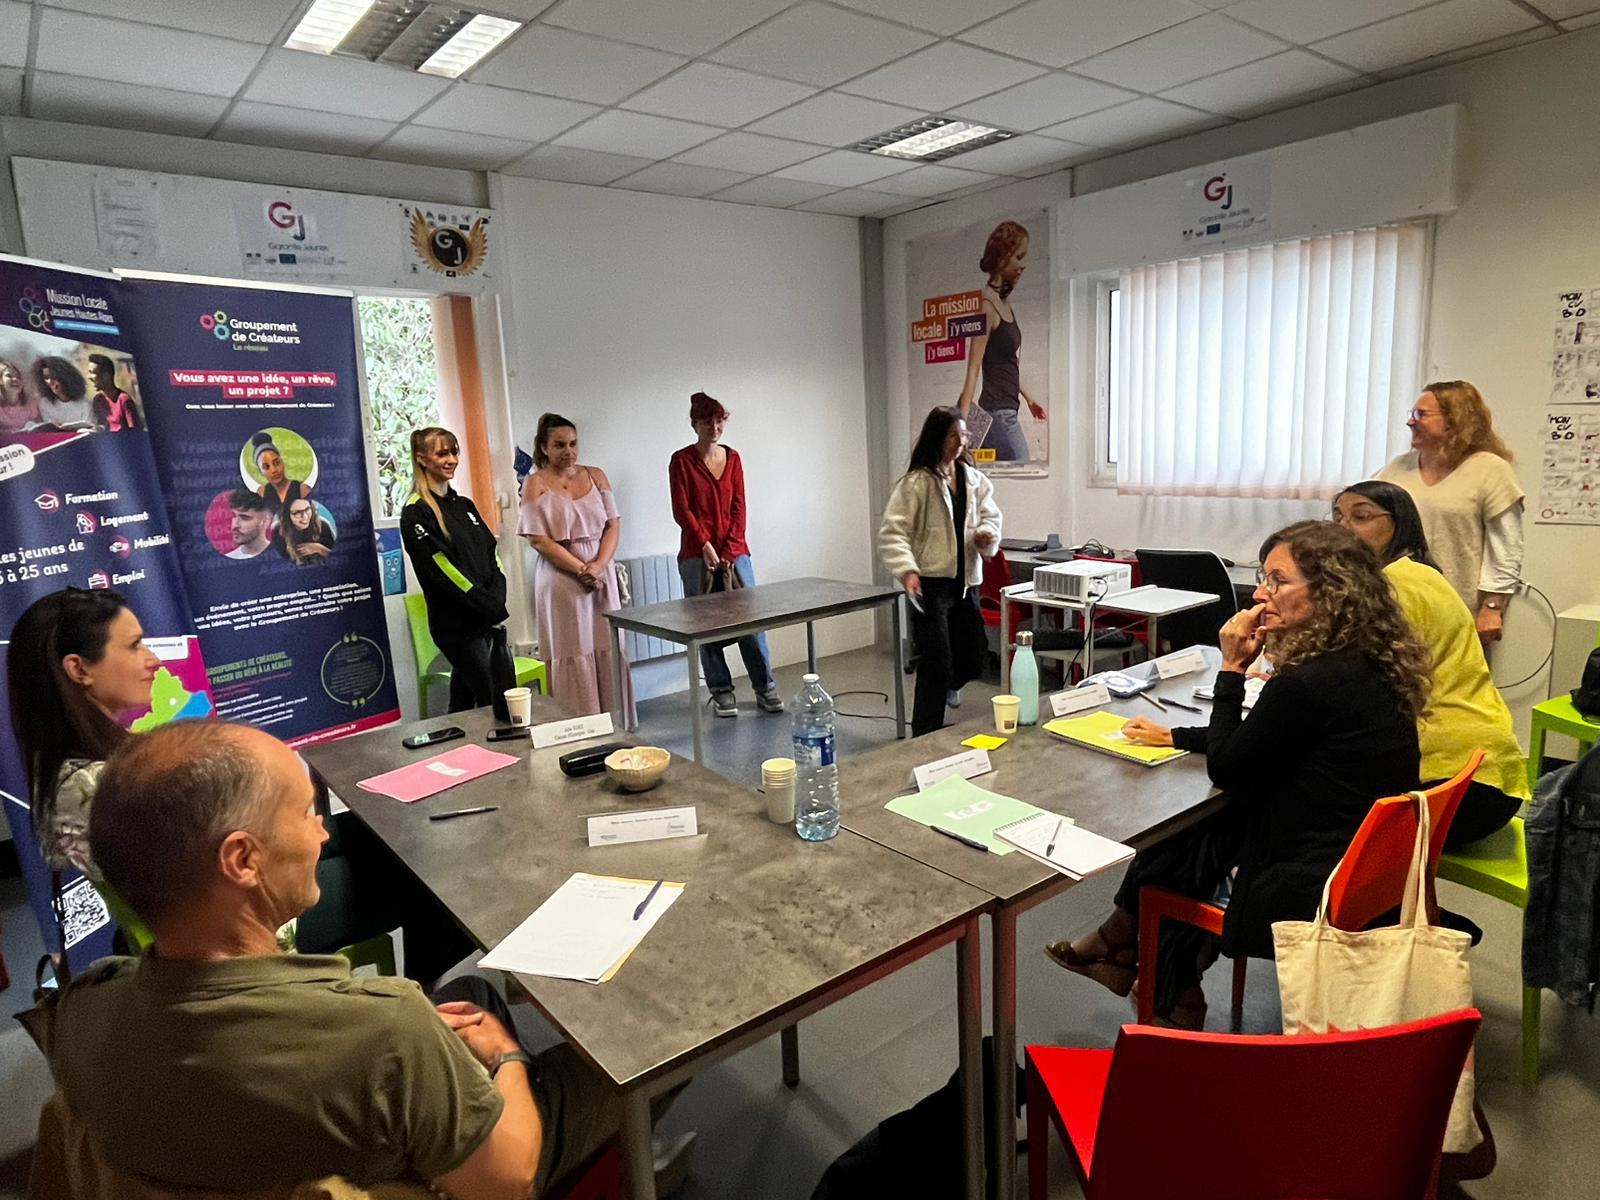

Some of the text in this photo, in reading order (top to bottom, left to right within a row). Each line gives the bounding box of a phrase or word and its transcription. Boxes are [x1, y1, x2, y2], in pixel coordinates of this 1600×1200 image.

[46, 288, 108, 310] Mission Locale
[1560, 292, 1582, 301] MON
[925, 295, 979, 318] La mission
[1568, 300, 1583, 308] CV
[230, 319, 297, 332] Groupement
[913, 321, 981, 340] locale j'y viens
[232, 333, 300, 344] de Créateurs
[927, 342, 960, 360] j'y tiens !
[174, 372, 334, 385] Vous avez une idée, un rêve,
[228, 385, 289, 398] un projet ?
[1550, 416, 1571, 424] MON
[65, 491, 118, 504] Formation
[100, 512, 149, 527] Logement
[0, 539, 84, 564] es jeunes de
[7, 569, 17, 582] à
[19, 564, 39, 580] 25
[43, 564, 68, 575] ans
[112, 570, 145, 585] Emploi
[210, 604, 229, 612] Envie
[266, 601, 288, 610] propre
[258, 614, 299, 626] Groupement
[310, 607, 340, 616] Créateurs
